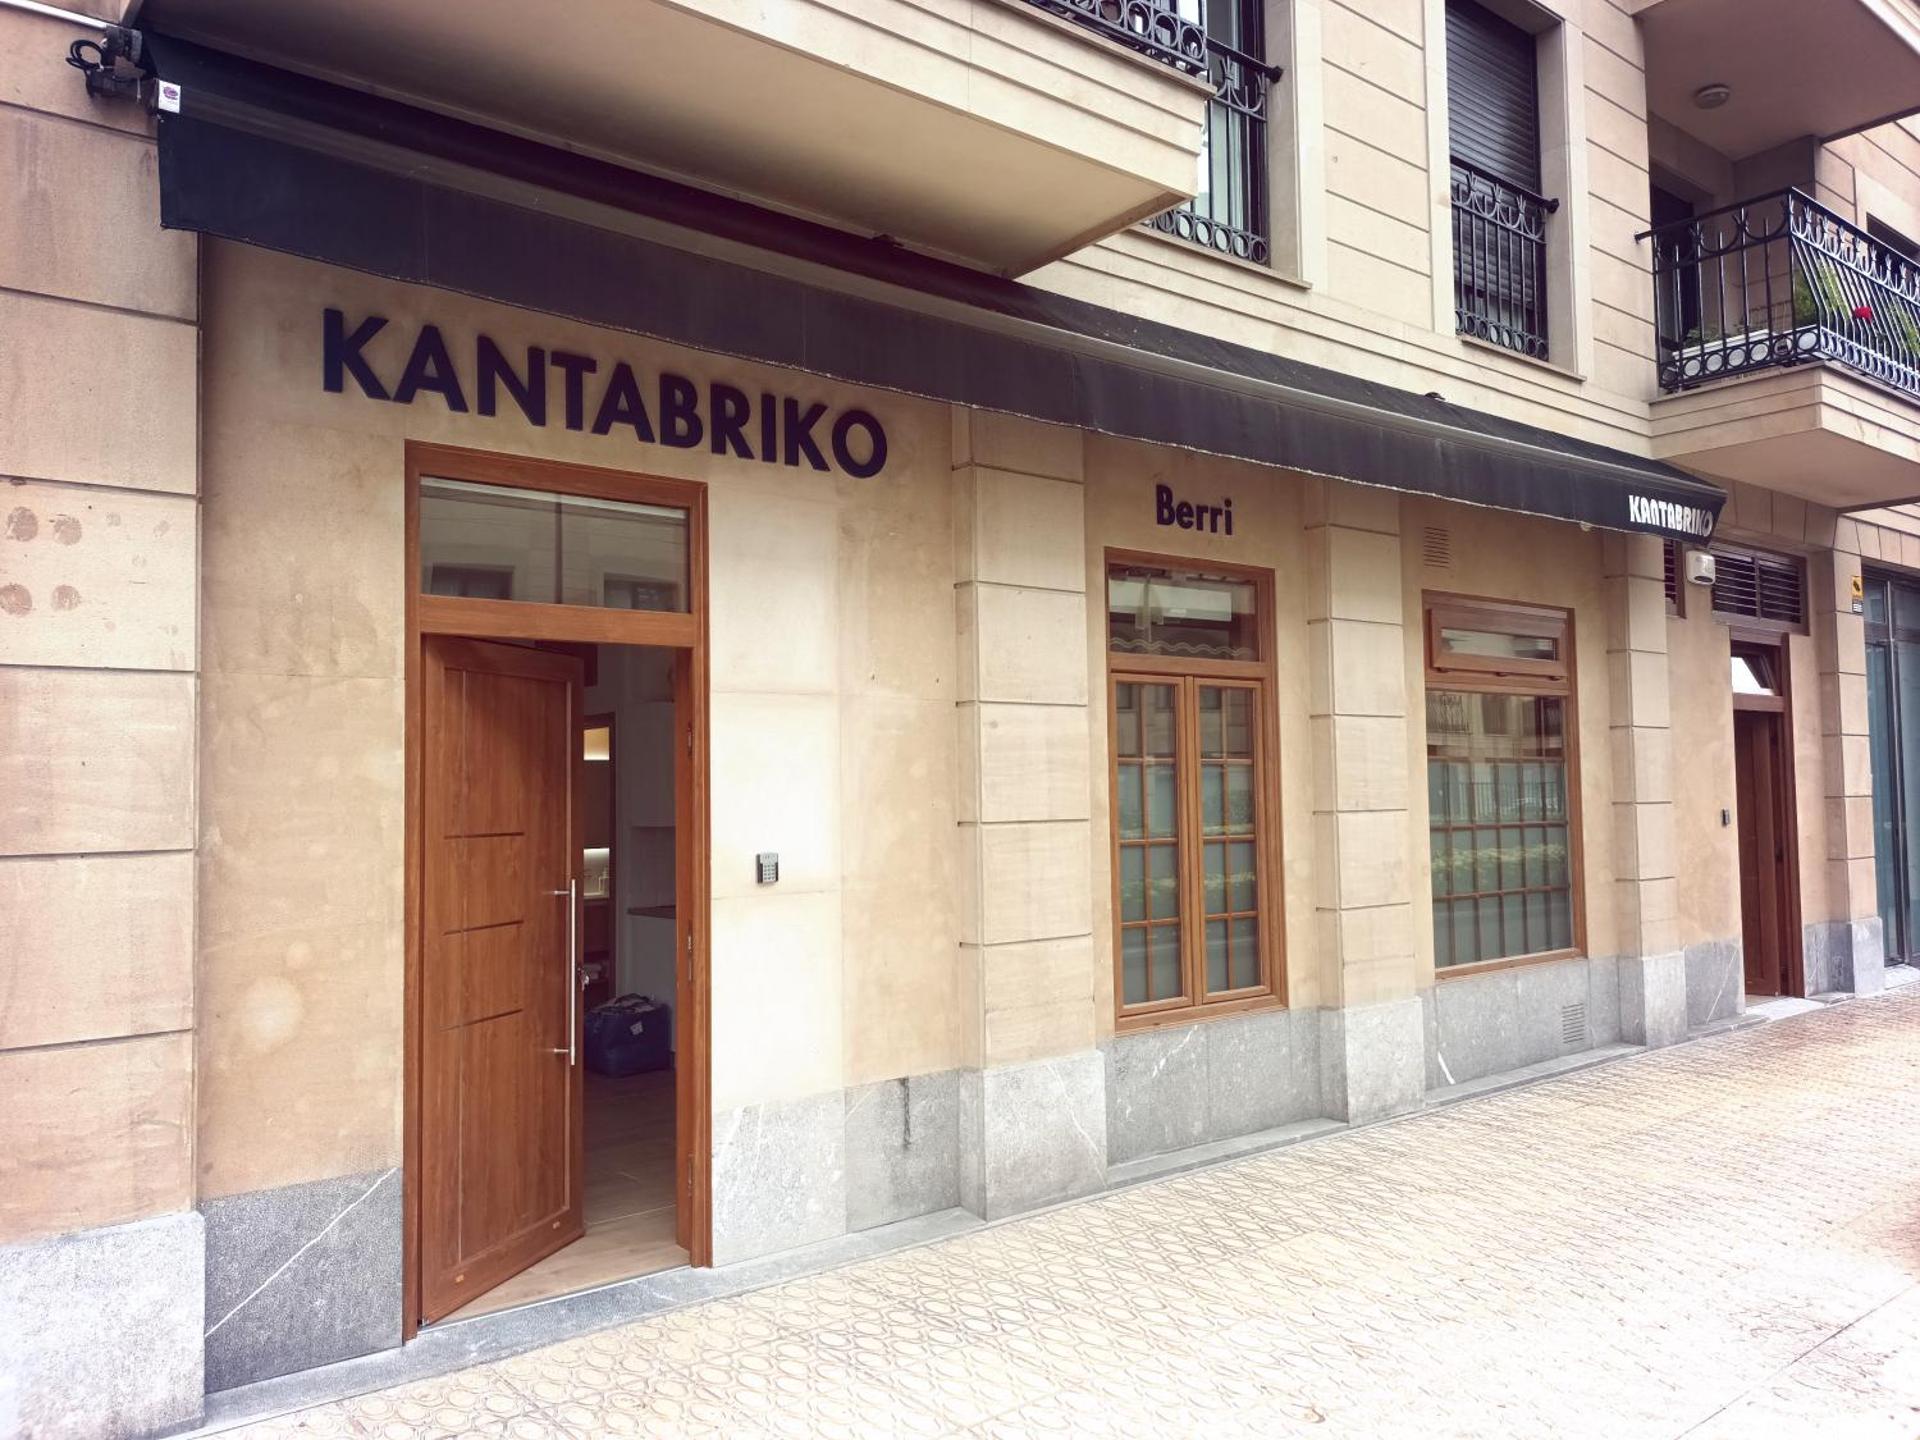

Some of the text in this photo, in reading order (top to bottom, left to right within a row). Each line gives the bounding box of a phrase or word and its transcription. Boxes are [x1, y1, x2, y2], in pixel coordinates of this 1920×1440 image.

[323, 307, 888, 478] KANTABRIKO
[1156, 484, 1232, 536] Berri
[1628, 494, 1714, 537] KANTABRIKO
